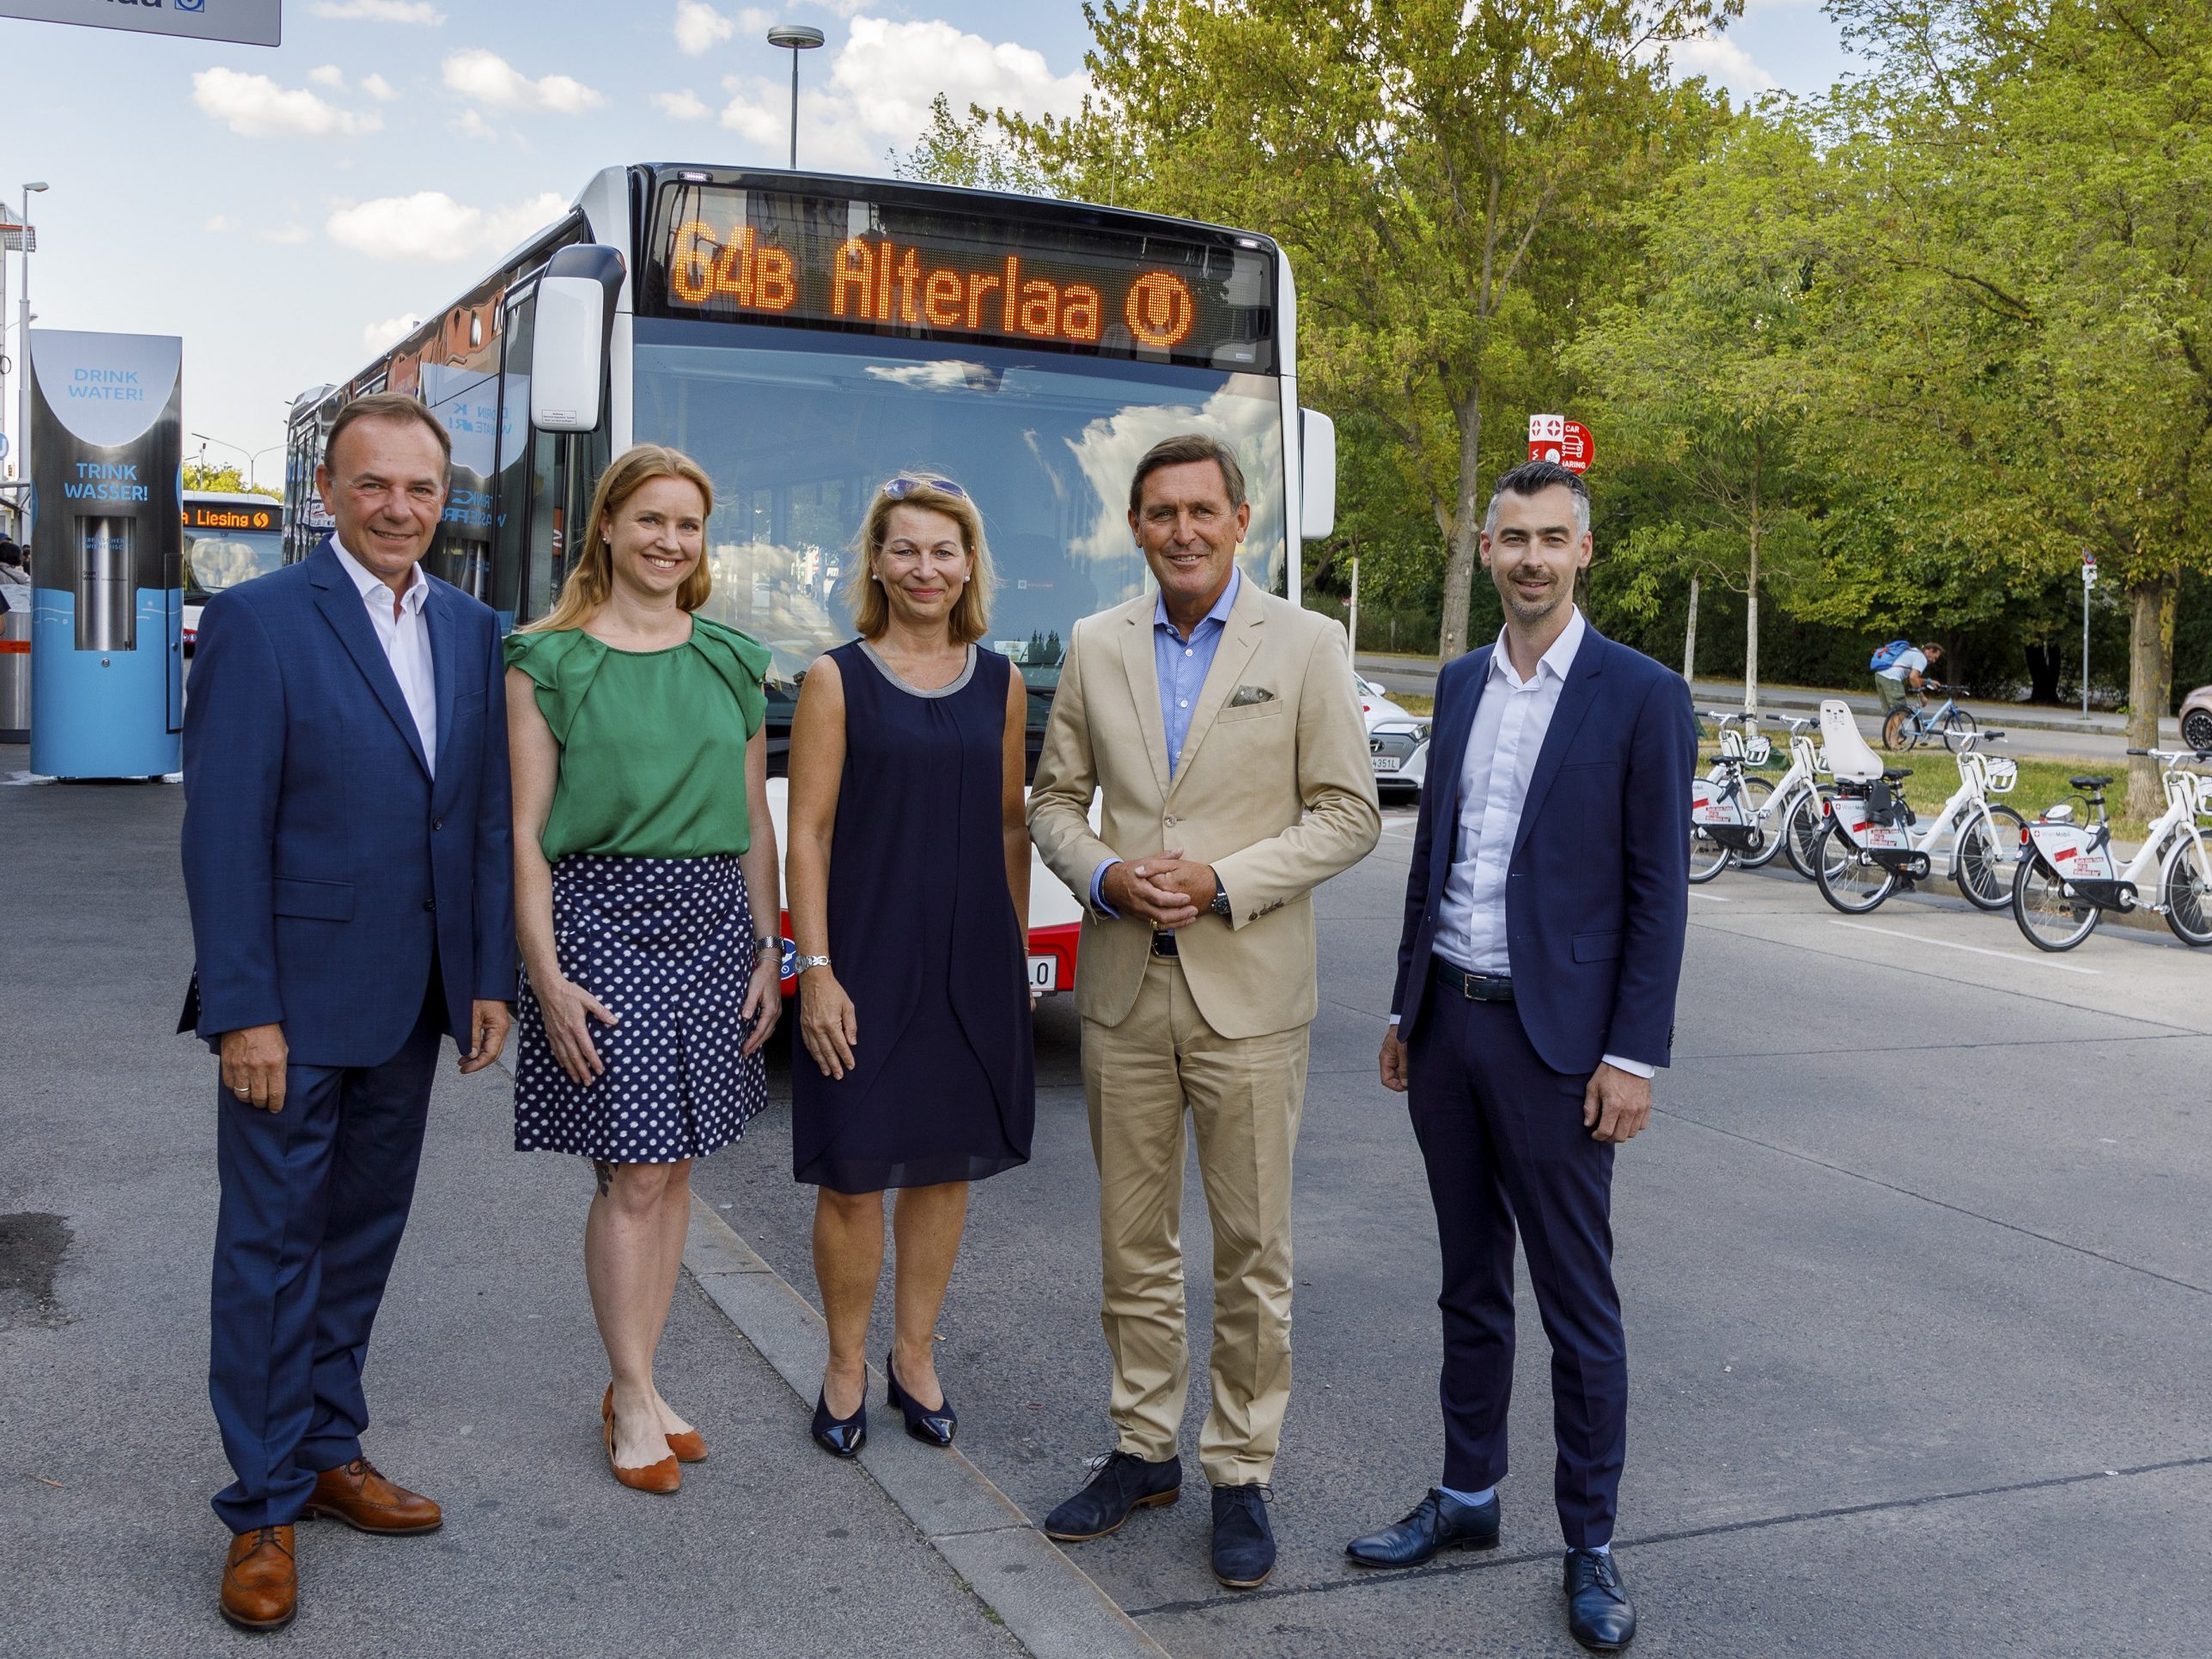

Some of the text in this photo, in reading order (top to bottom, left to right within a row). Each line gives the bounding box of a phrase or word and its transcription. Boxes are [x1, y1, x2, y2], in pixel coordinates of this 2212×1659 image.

[674, 221, 794, 309] 64B
[833, 238, 1099, 340] Alterlaa
[74, 369, 138, 384] DRINK
[68, 385, 143, 400] WATER!
[76, 462, 137, 480] TRINK
[1562, 460, 1586, 469] ARING
[64, 482, 148, 501] WASSER!
[198, 509, 249, 528] Liesing
